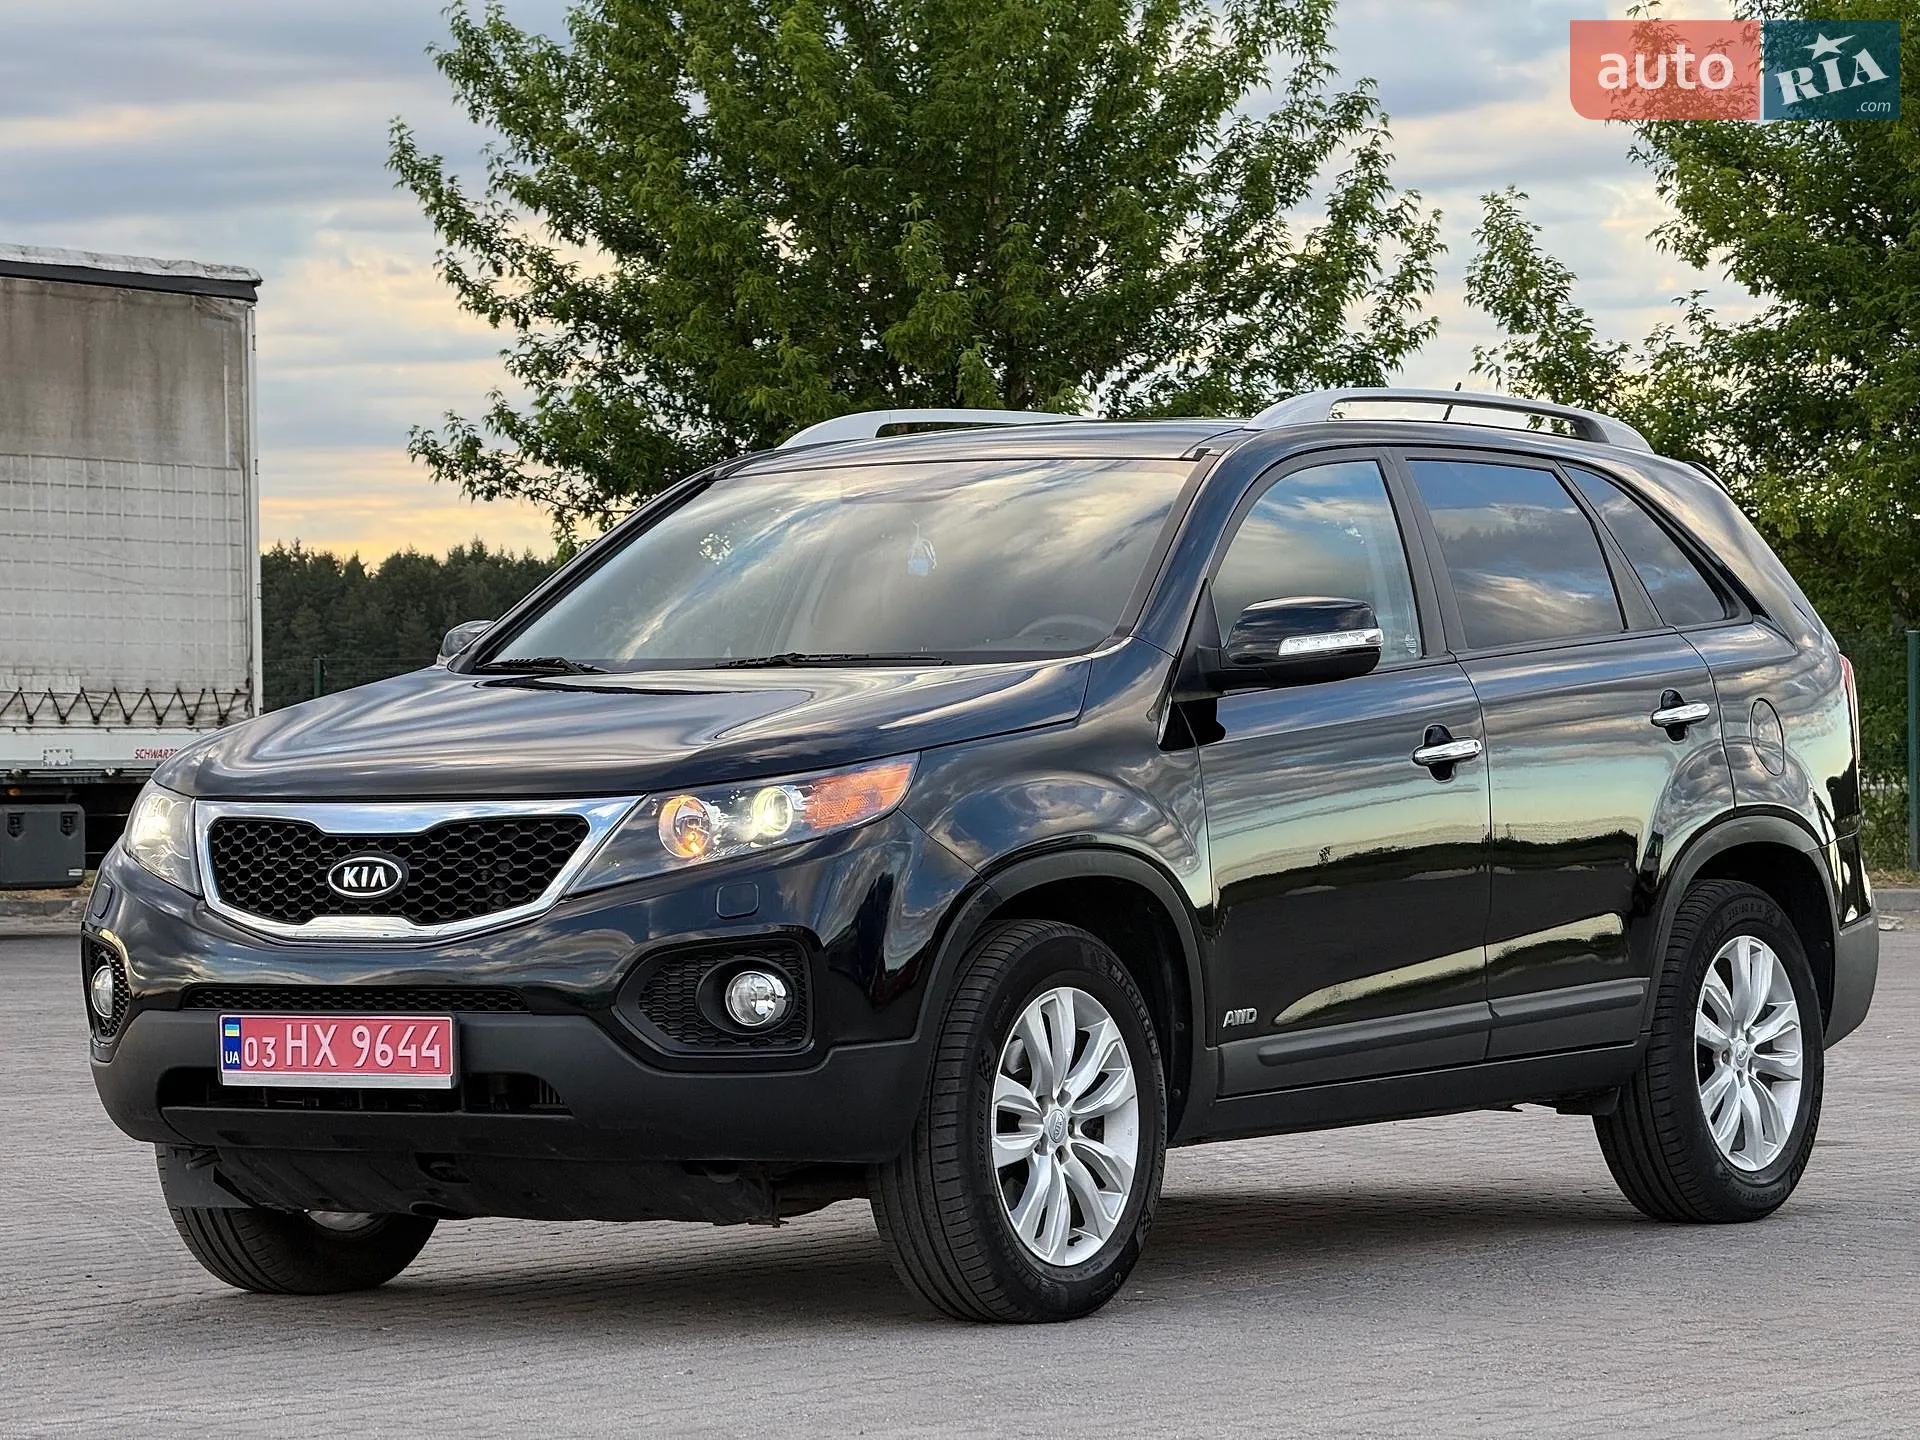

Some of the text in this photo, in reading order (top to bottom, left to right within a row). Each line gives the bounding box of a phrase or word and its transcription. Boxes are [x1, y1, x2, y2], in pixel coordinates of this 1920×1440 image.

[343, 866, 387, 888] KIA
[1110, 964, 1158, 1057] MICHELIN
[1222, 1008, 1257, 1028] AWD
[225, 1050, 240, 1064] UA
[244, 1024, 441, 1068] 03 HX 9644
